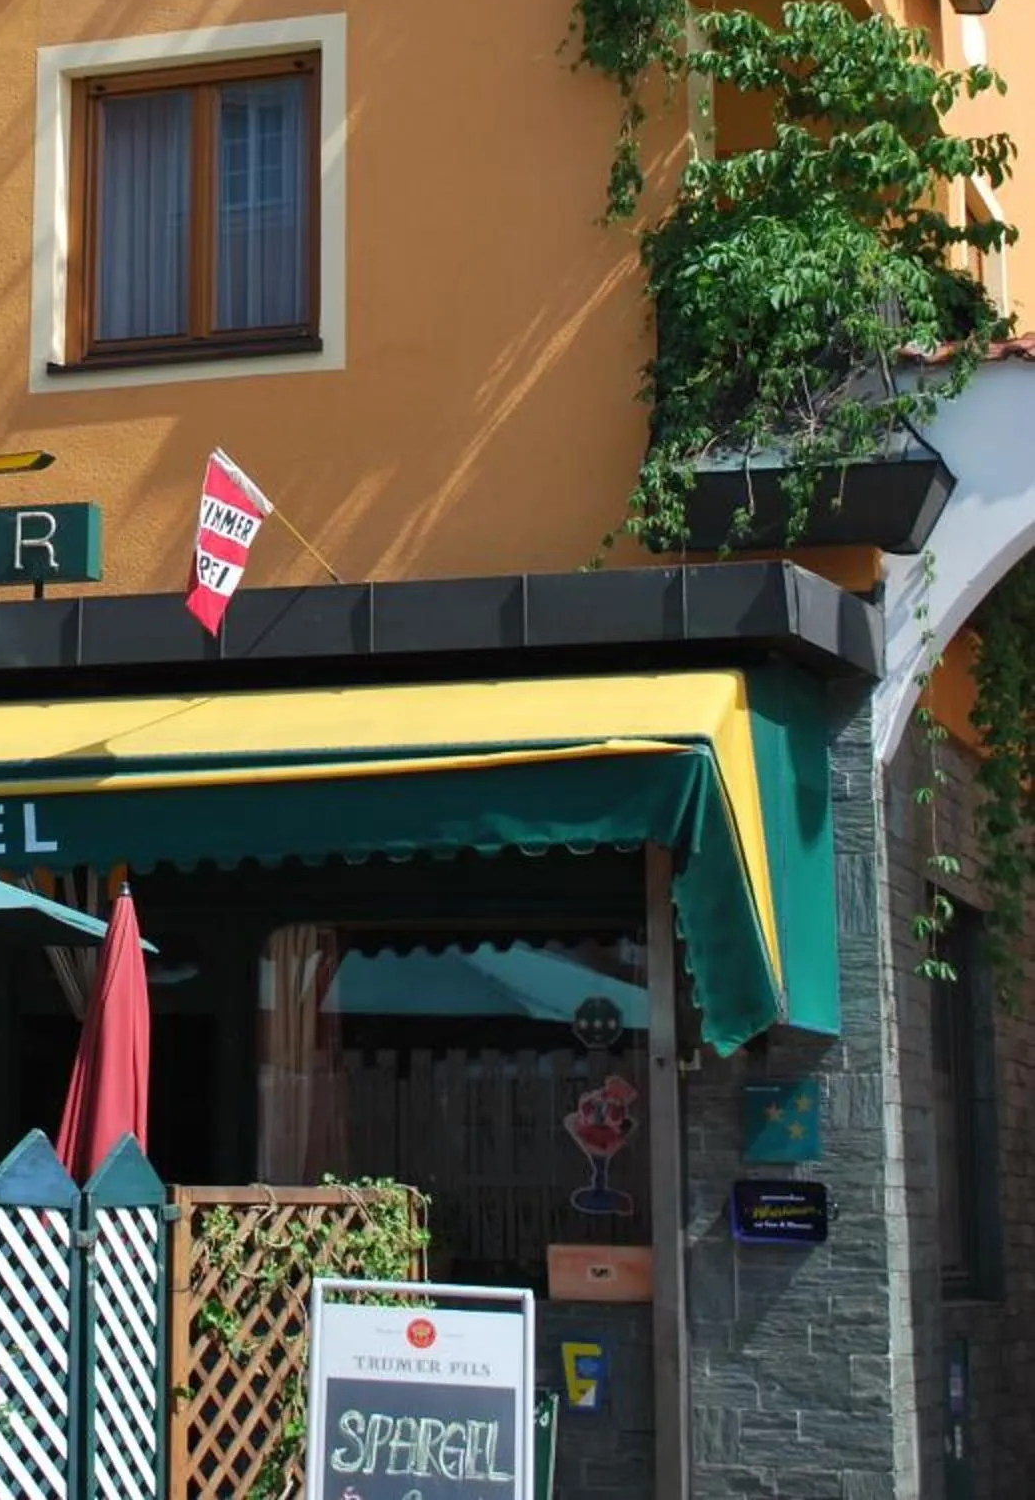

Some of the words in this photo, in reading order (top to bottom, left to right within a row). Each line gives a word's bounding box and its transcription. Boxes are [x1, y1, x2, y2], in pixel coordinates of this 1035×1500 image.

[203, 498, 254, 542] IMMER
[198, 555, 230, 589] REI
[449, 1361, 492, 1378] PILS
[330, 1409, 516, 1482] SPARGEL
